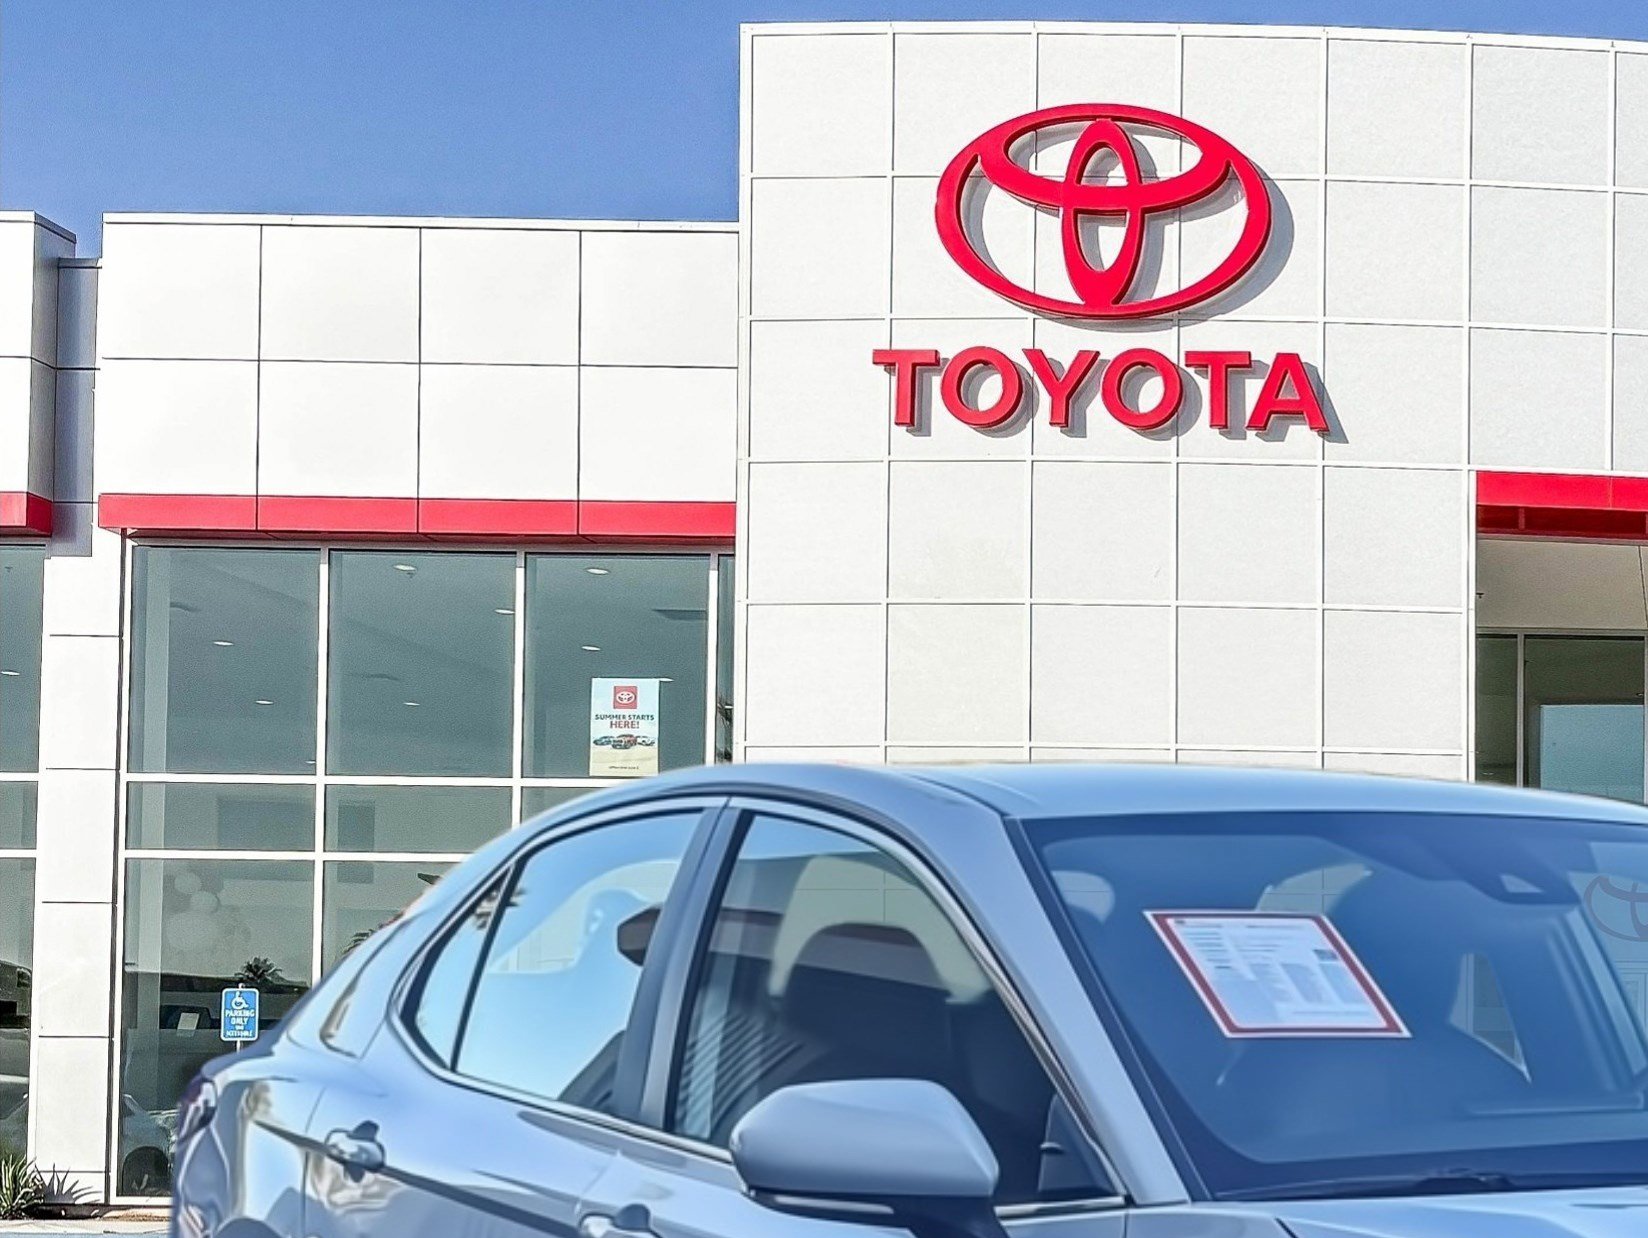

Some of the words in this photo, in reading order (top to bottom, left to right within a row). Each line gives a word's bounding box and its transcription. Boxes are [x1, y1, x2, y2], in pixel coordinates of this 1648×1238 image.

[872, 346, 1330, 432] TOYOTA
[609, 720, 640, 729] HERE!
[225, 1009, 255, 1017] PARKING
[230, 1017, 249, 1025] ONLY
